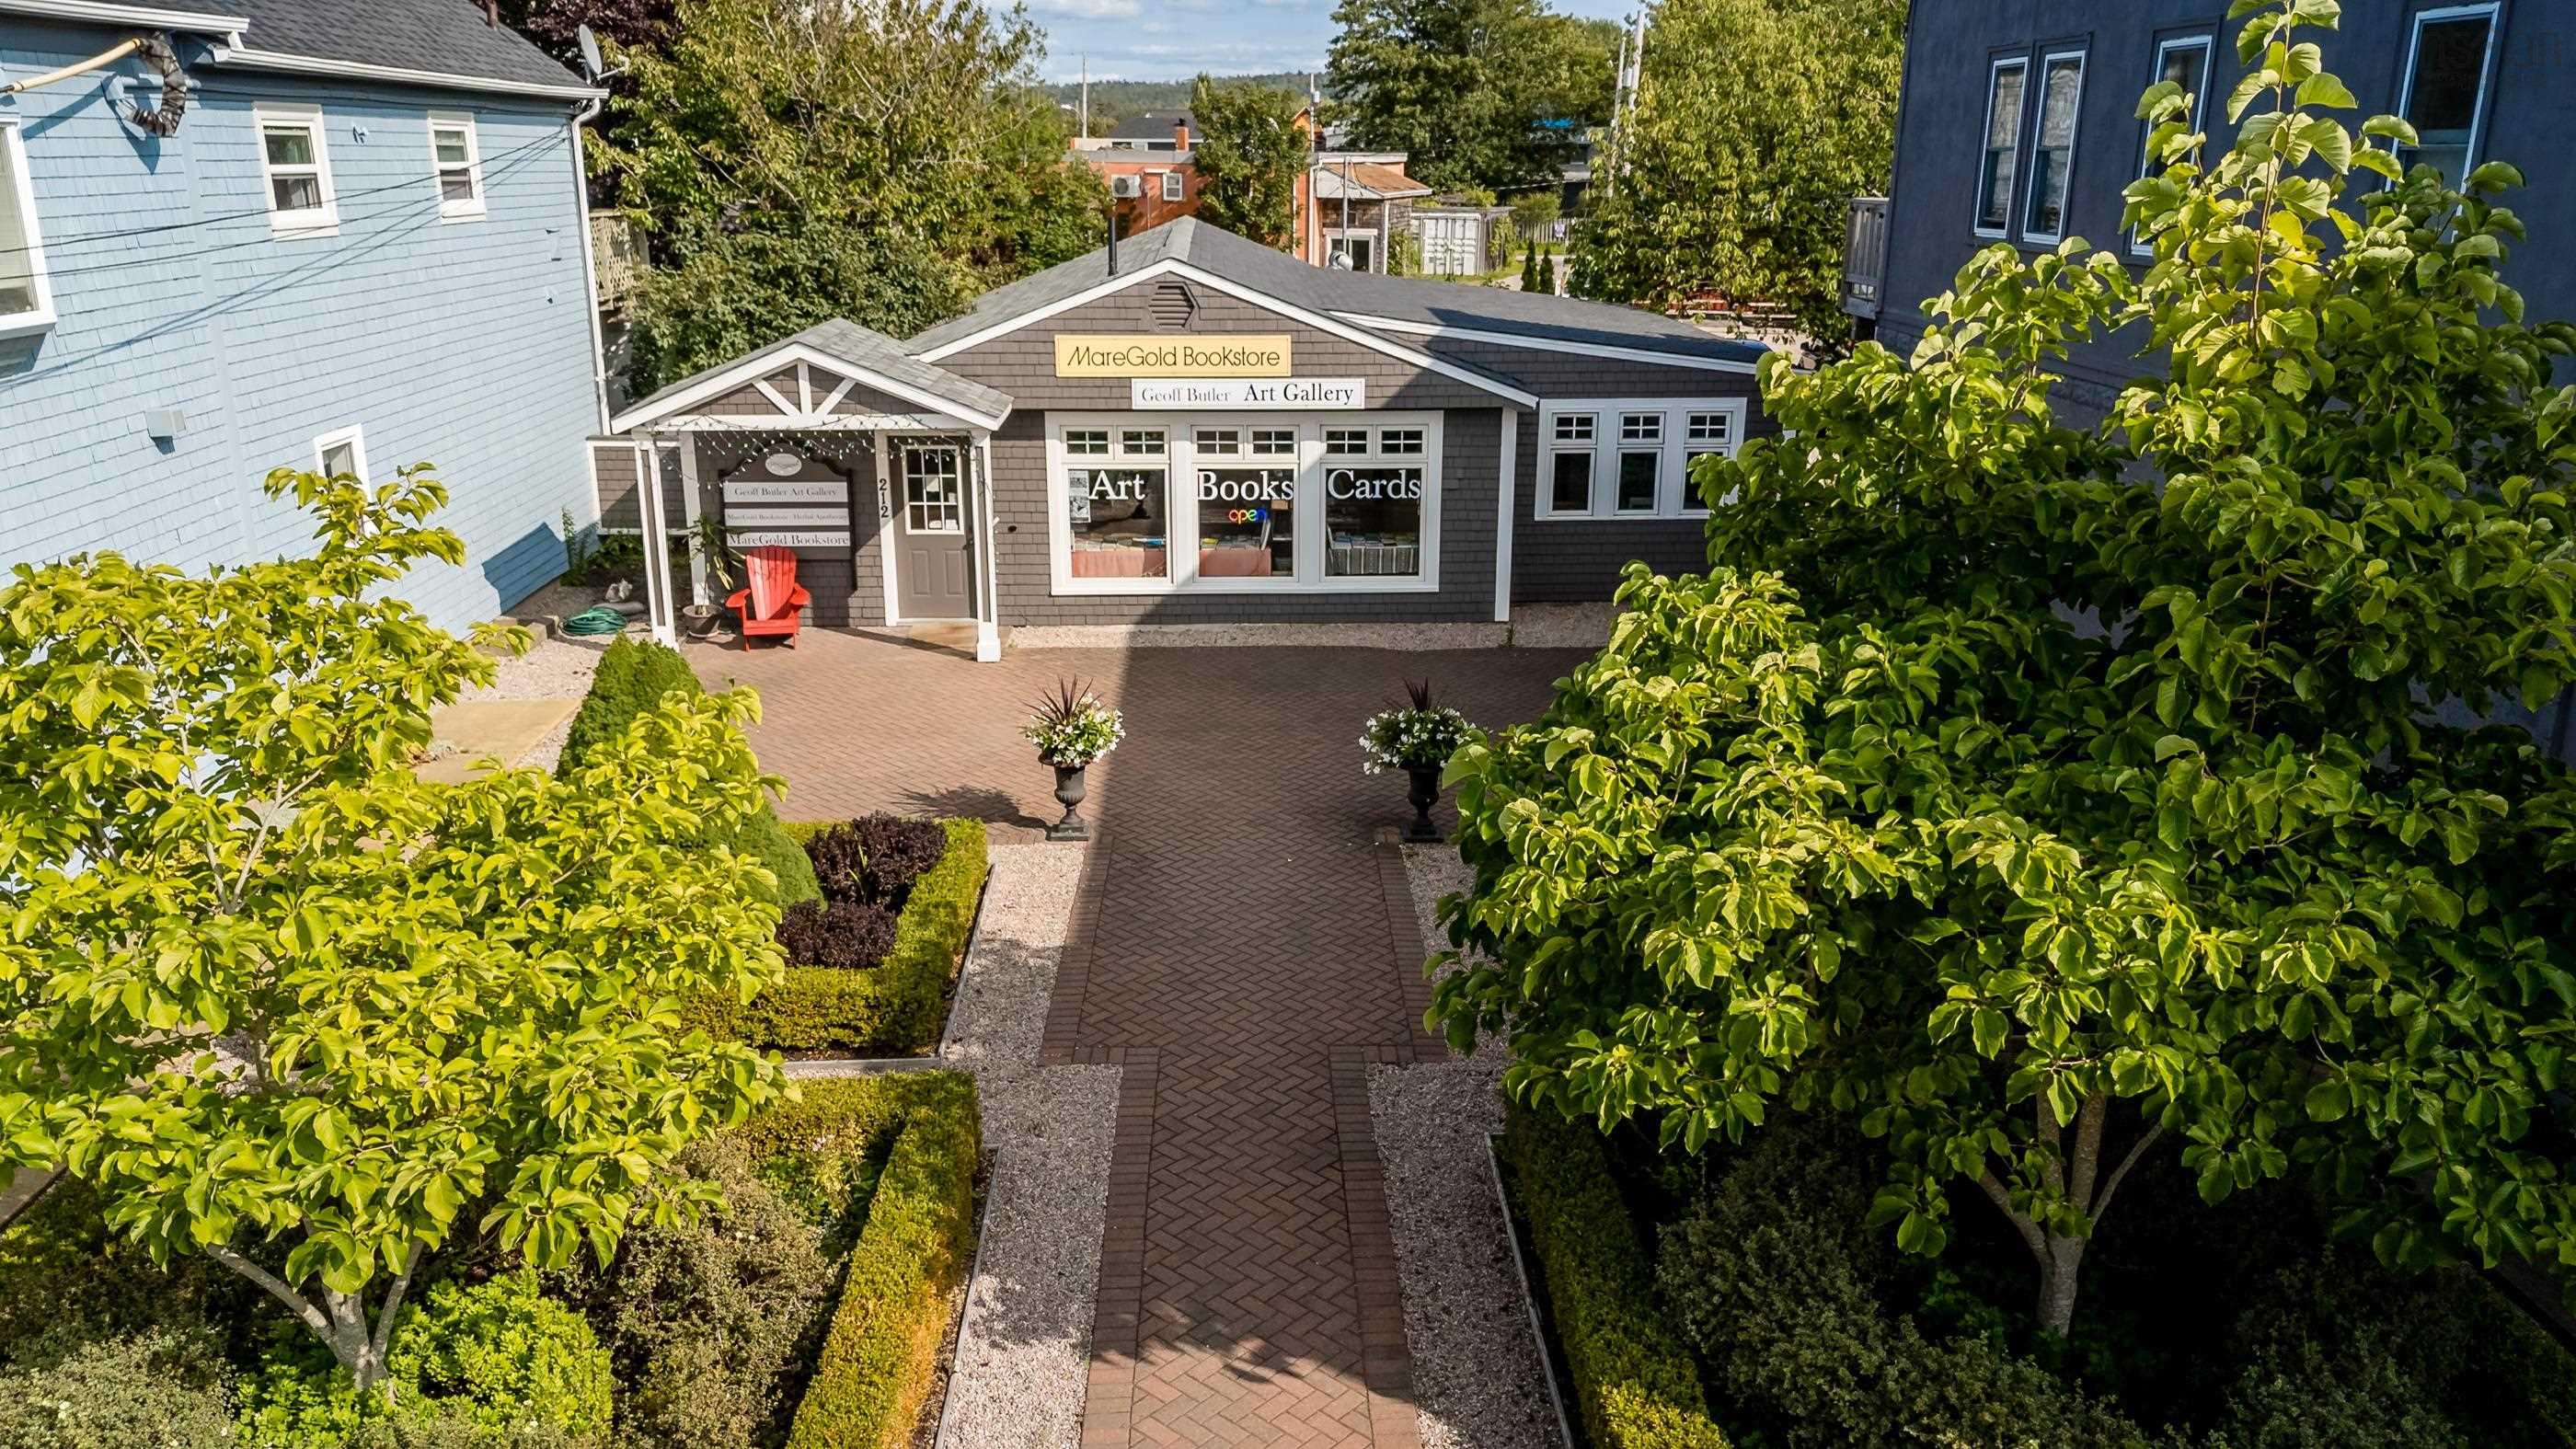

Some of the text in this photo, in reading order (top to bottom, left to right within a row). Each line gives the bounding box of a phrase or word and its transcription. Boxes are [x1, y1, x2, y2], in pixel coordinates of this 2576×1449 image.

[1067, 346, 1177, 367] MareGold
[1142, 383, 1354, 406] Geoff Butler Art Gallery
[1087, 469, 1146, 500] Art
[1197, 470, 1294, 501] Books
[1328, 469, 1421, 500] Cards
[1228, 509, 1268, 525] open
[730, 534, 849, 546] MareGold Bookstore
